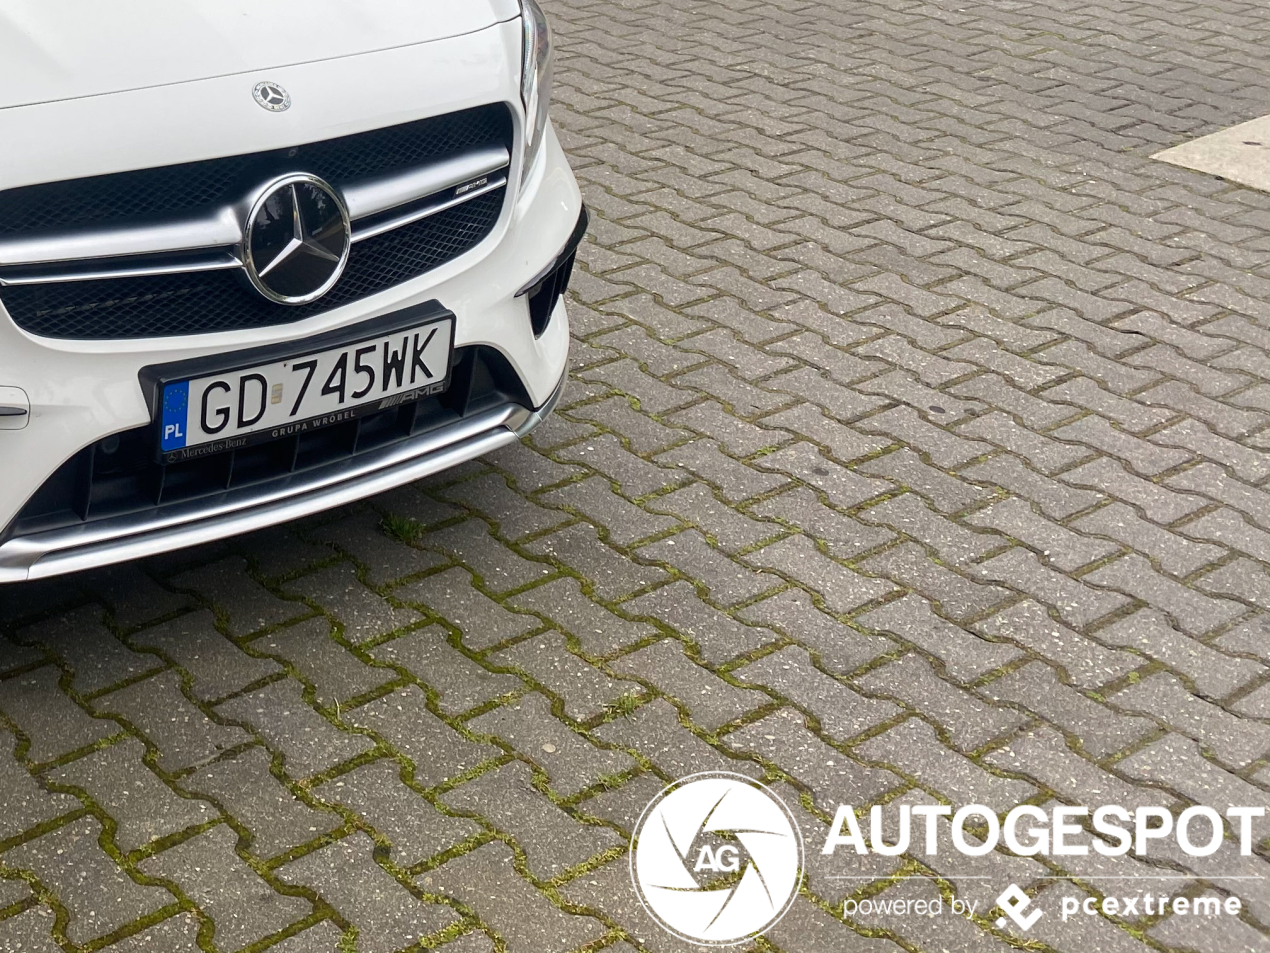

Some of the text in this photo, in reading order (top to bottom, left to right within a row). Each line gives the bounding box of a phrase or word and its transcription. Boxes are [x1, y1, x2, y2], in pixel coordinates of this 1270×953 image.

[200, 327, 439, 435] GD 745WK
[402, 381, 445, 400] AMG
[164, 423, 183, 440] PL
[272, 410, 355, 438] GRUPA WRÓBEL
[180, 438, 247, 459] Mercedes-Benz
